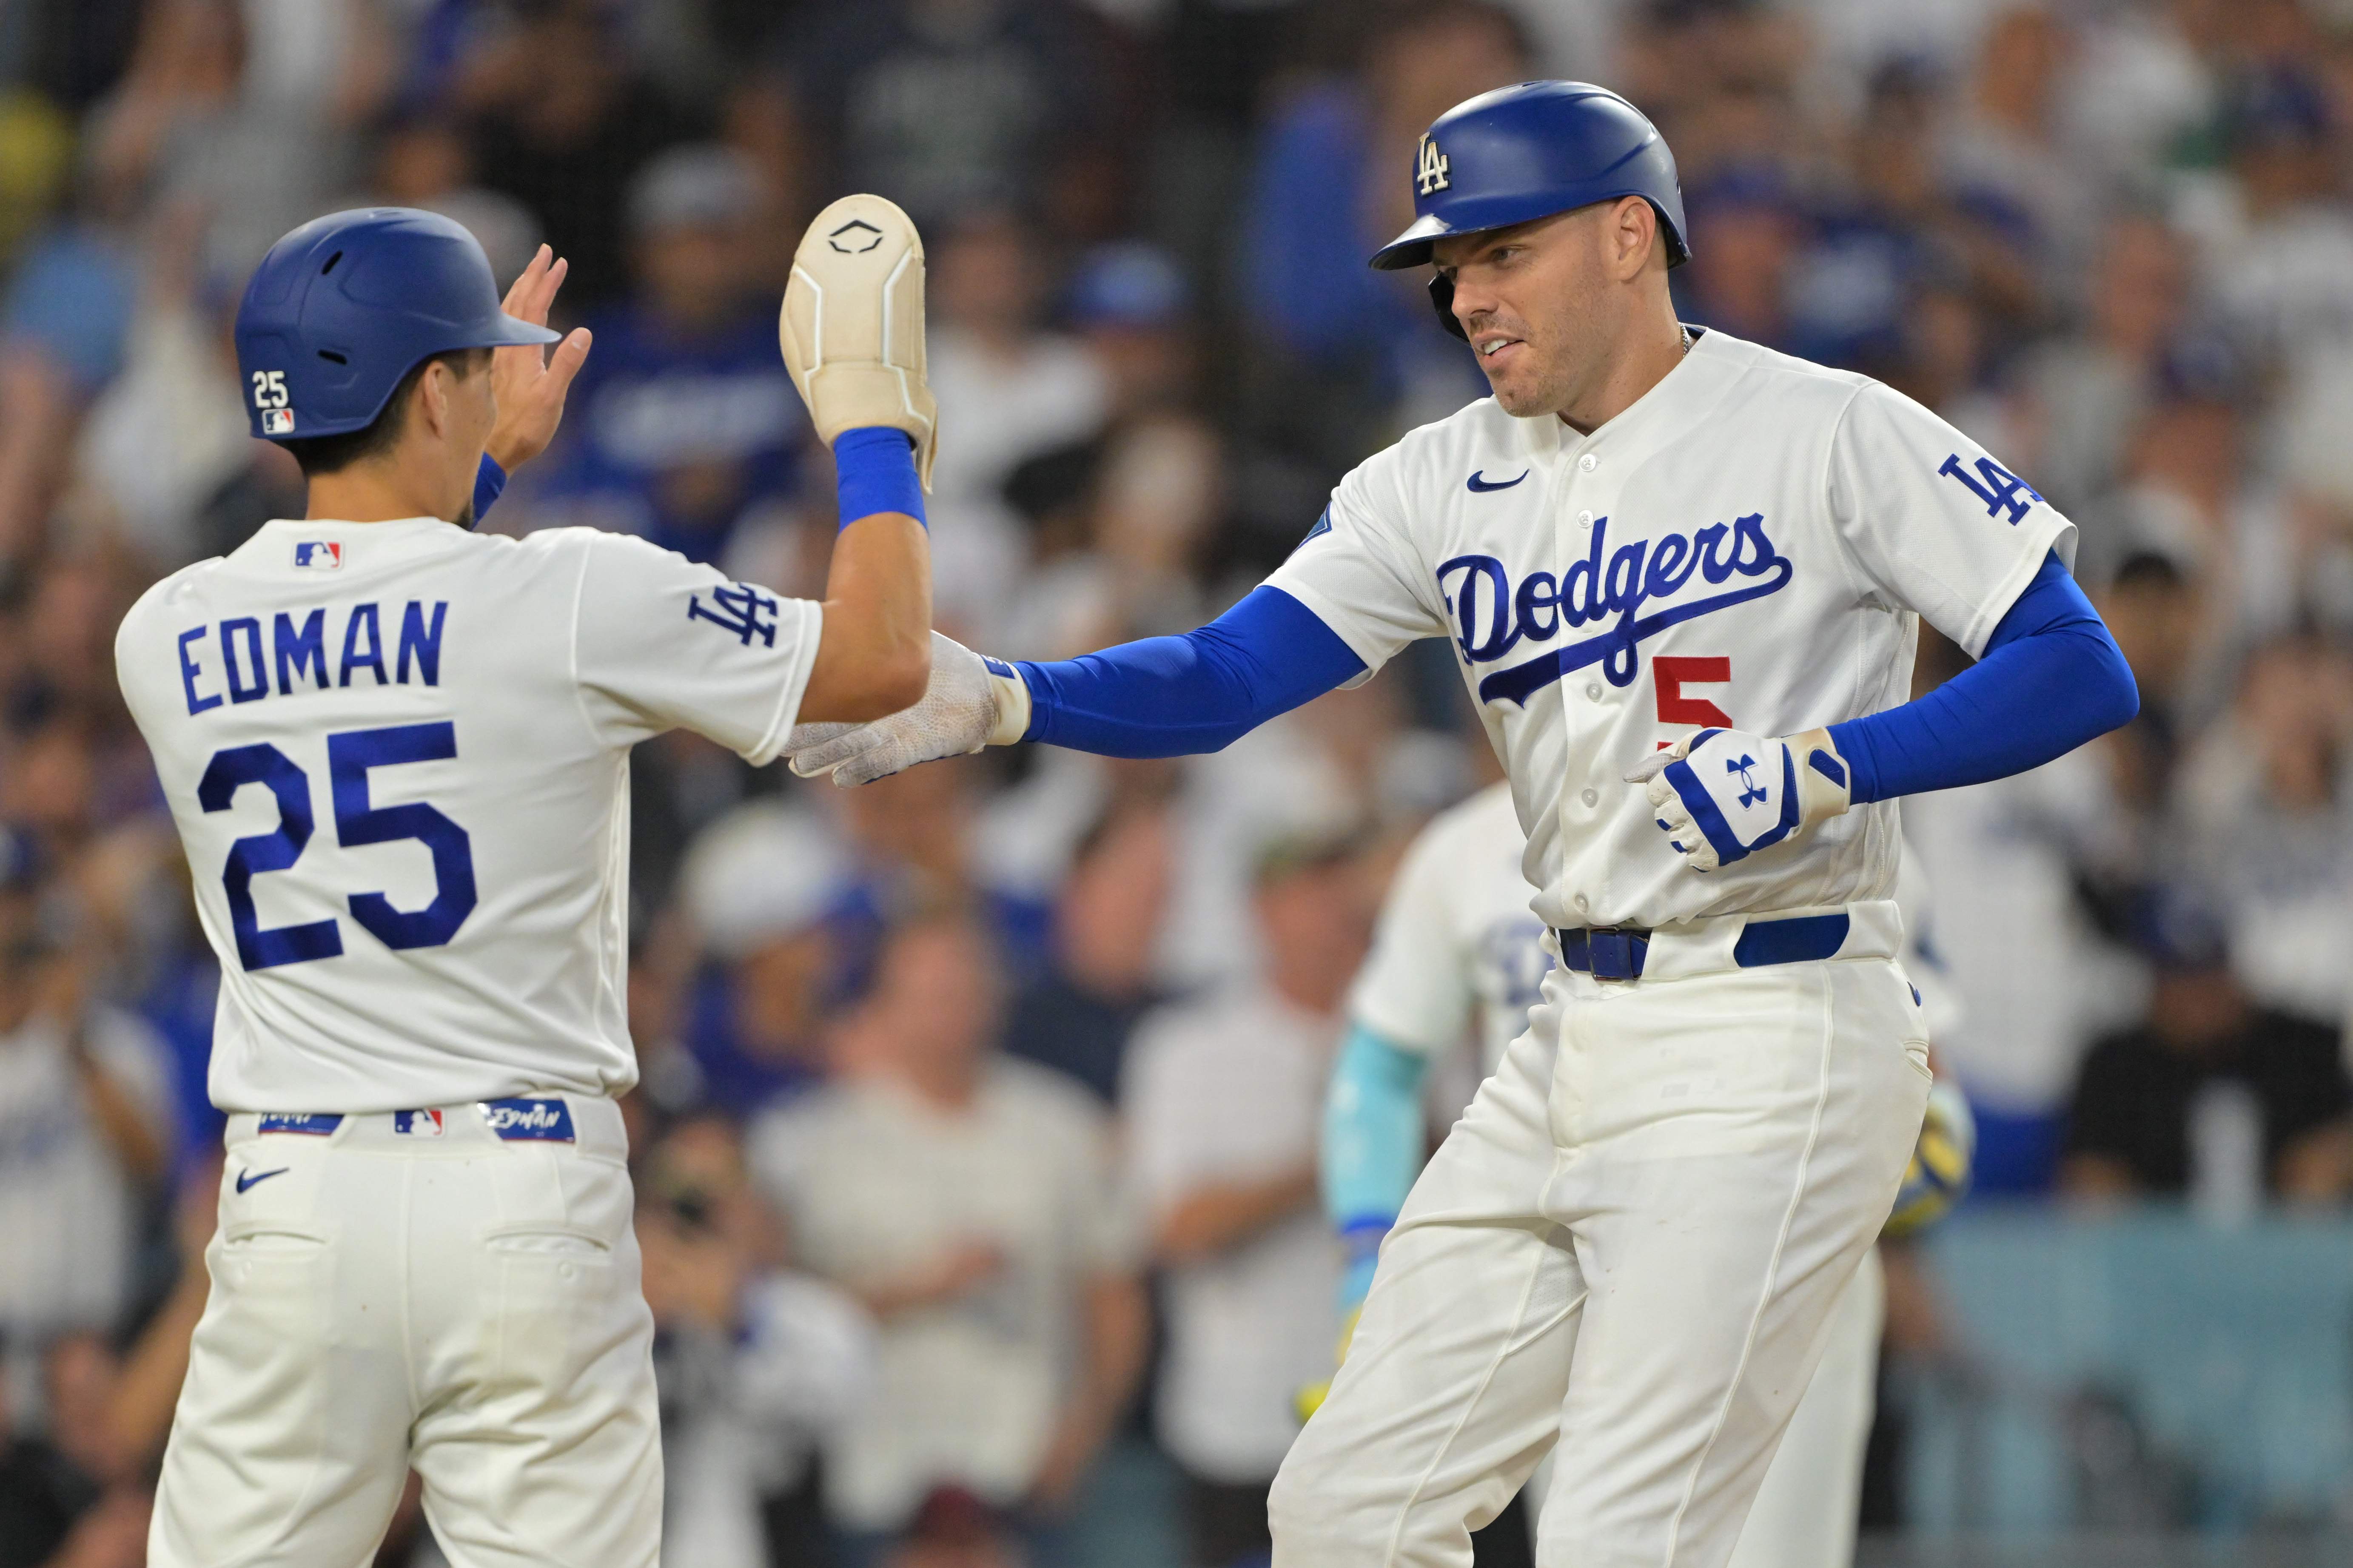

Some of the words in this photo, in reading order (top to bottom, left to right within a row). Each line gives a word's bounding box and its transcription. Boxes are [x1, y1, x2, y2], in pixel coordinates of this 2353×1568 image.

[1417, 131, 1449, 196] LA
[252, 370, 288, 408] 25
[1938, 453, 2045, 526] LA
[688, 582, 778, 648] LA
[1436, 512, 1789, 688] Dodgers
[177, 600, 449, 716] EDMAN
[198, 721, 478, 972] 25
